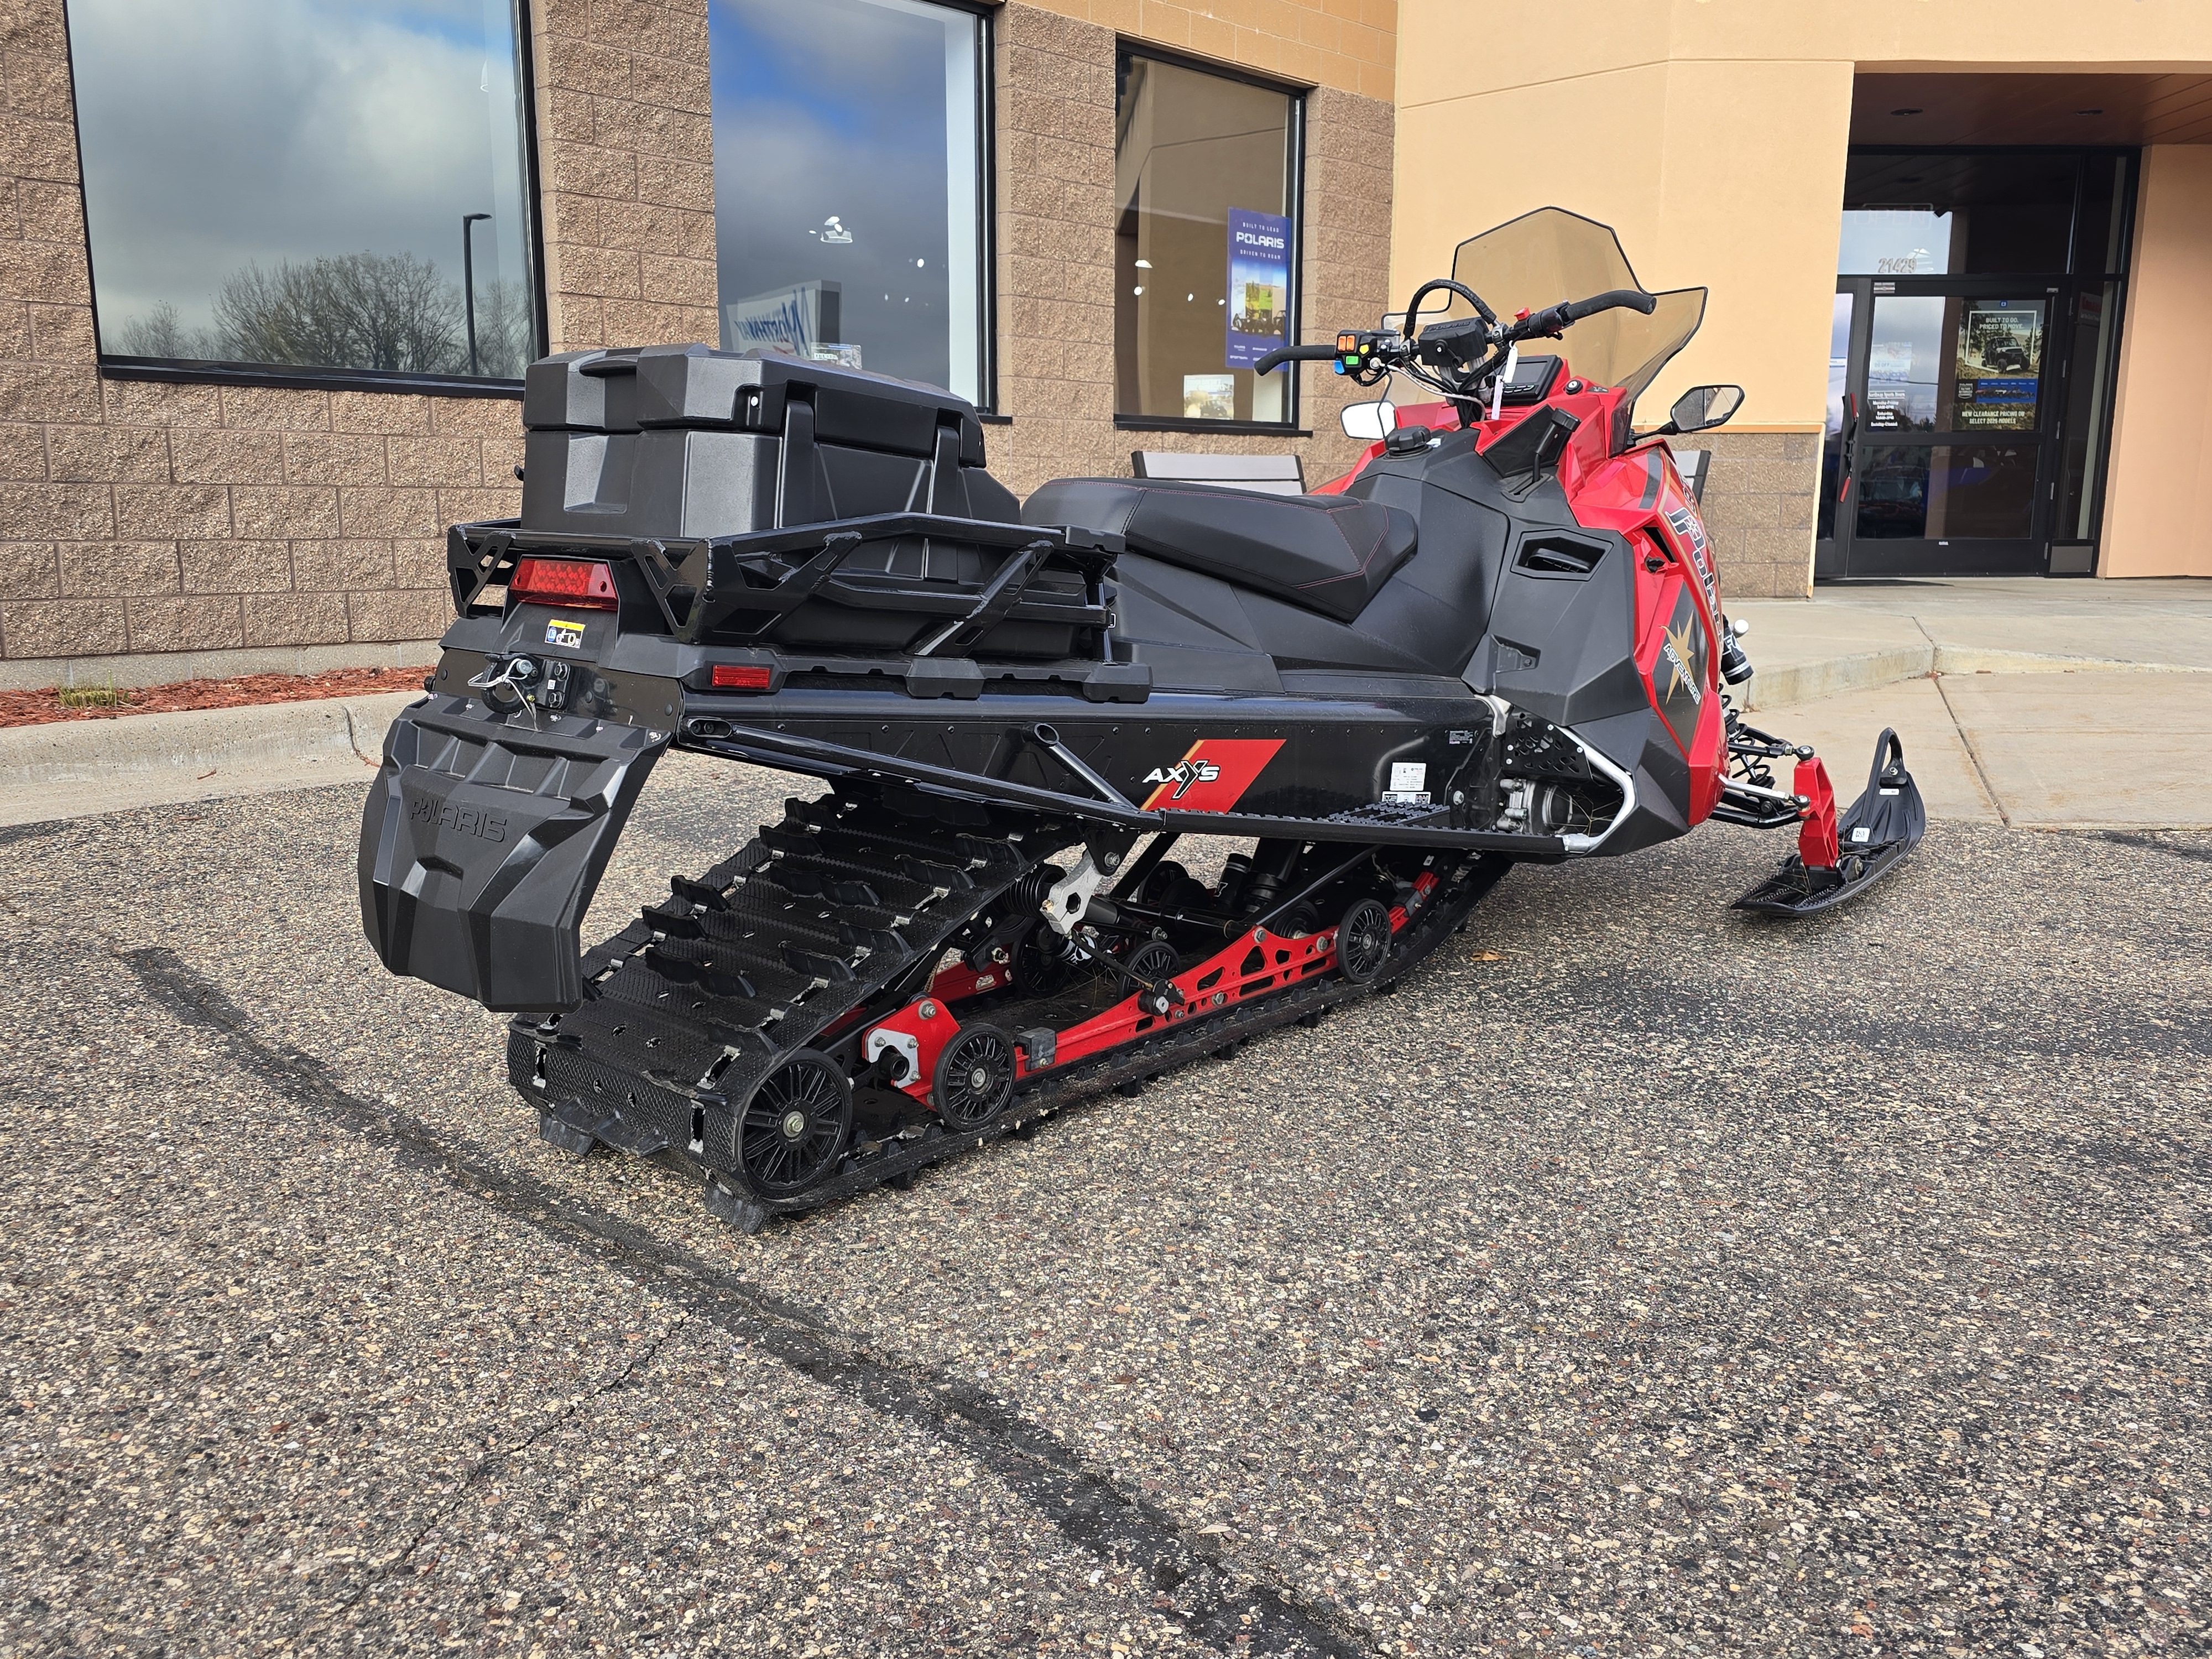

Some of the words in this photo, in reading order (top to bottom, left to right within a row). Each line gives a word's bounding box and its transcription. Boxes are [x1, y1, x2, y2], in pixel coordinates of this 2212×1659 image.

[1236, 231, 1285, 249] POLARIS
[1878, 258, 1917, 273] 21429
[1663, 643, 1701, 705] ADVENTURE
[1142, 759, 1220, 800] AXYS
[410, 797, 508, 843] POLARIS
